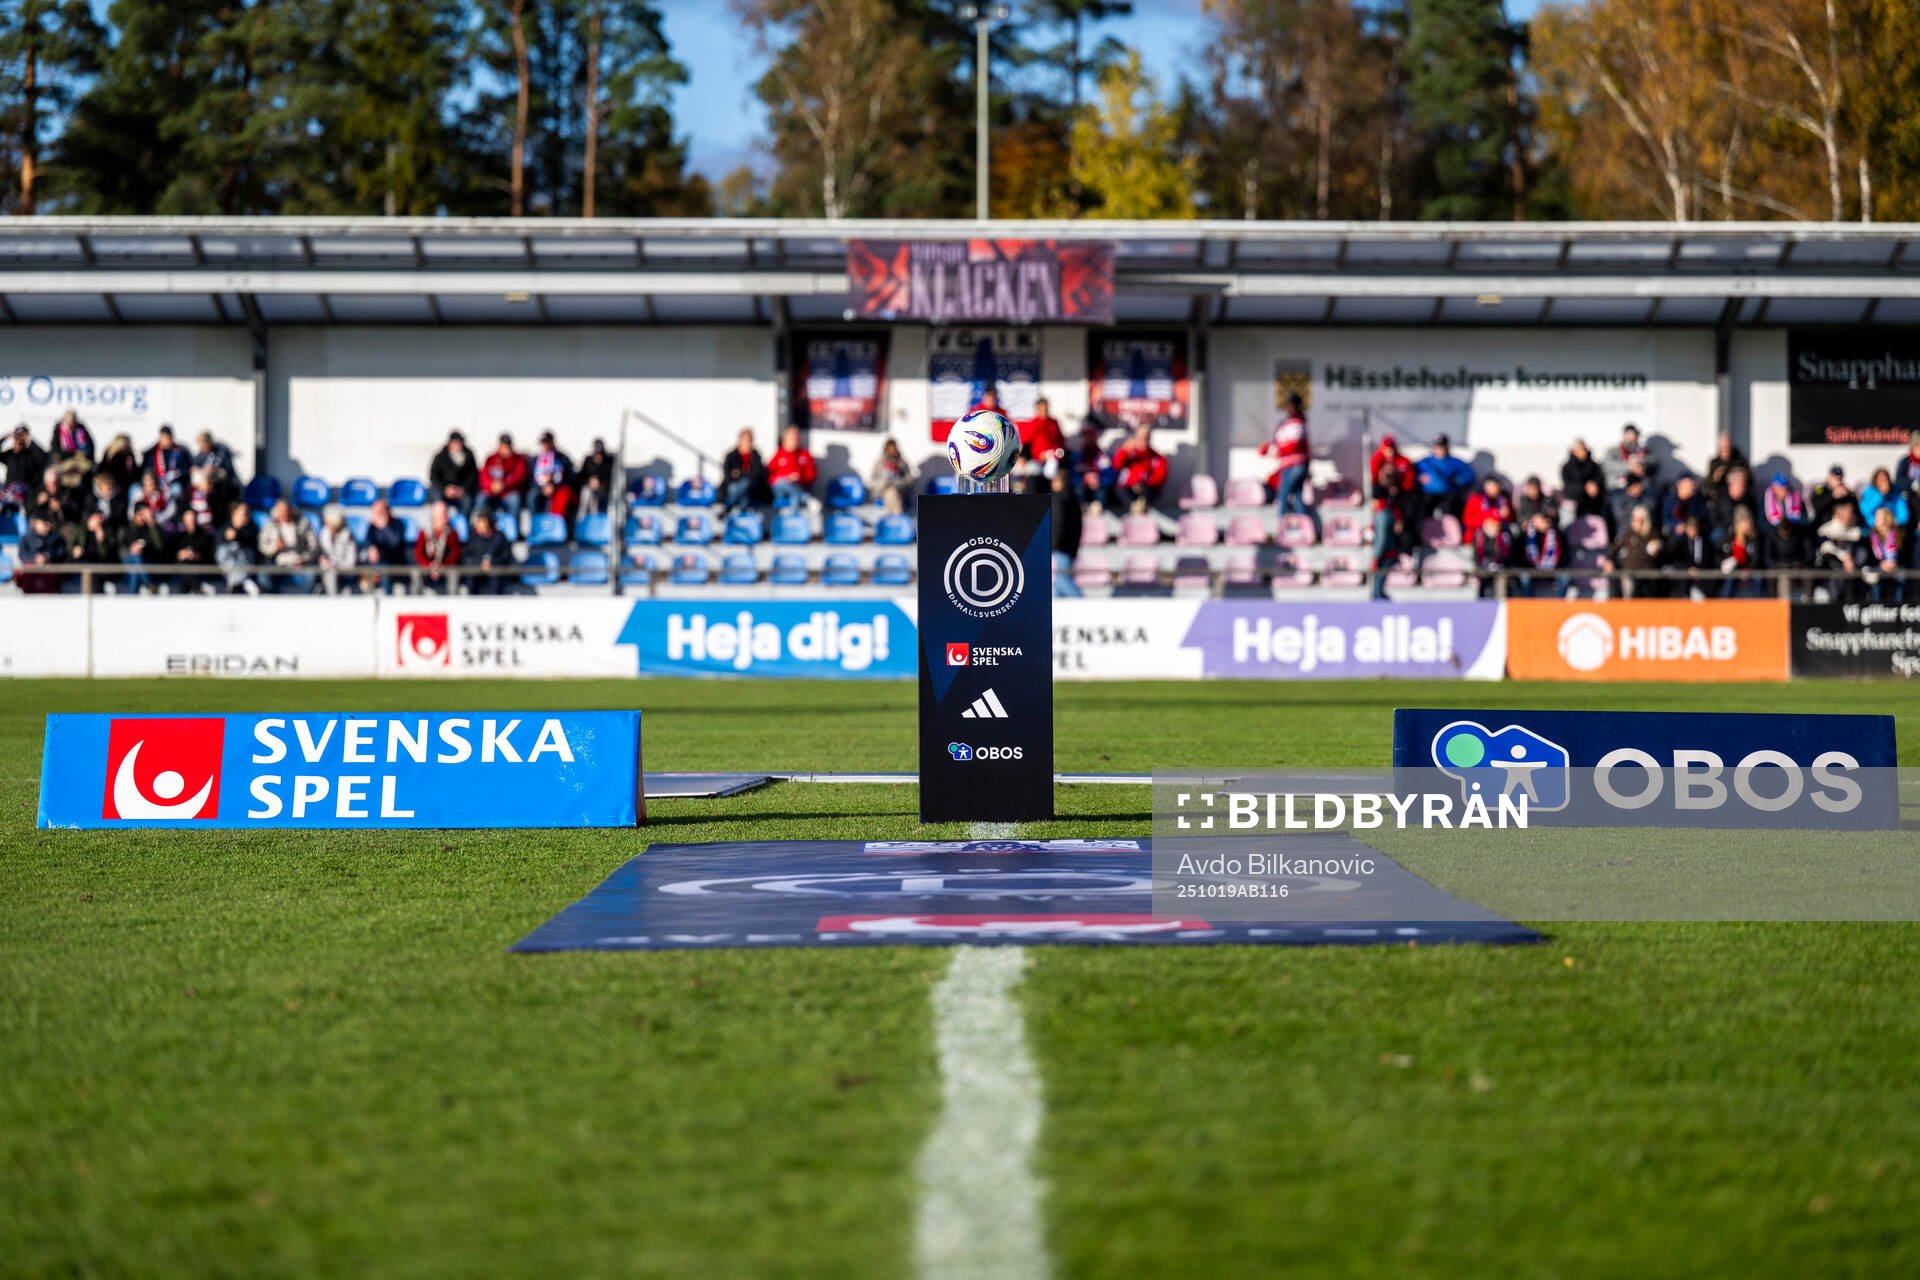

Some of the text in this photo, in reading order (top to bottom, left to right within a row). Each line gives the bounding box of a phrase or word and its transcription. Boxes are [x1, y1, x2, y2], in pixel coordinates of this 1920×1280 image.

[1324, 364, 1647, 389] Hässleholms kommun
[1798, 350, 1920, 390] Snappha
[27, 374, 148, 413] Omsorg
[969, 536, 1000, 547] OBOS
[948, 593, 1021, 618] DAMALLSVENSKAN
[461, 621, 585, 643] SVENSKA
[667, 610, 889, 671] Heja dig!
[1053, 625, 1149, 645] ENSKA
[1232, 613, 1454, 673] Heja alla!
[1619, 626, 1738, 660] HIBAB
[1806, 627, 1920, 656] Snapphaneb
[461, 647, 522, 668] SPEL
[972, 646, 1023, 656] SVENSKA
[972, 657, 999, 666] SPEL
[1053, 650, 1088, 670] EL
[166, 653, 300, 675] ERIDAN
[251, 717, 575, 764] SVENSKA
[976, 746, 1023, 760] OBOS
[1593, 747, 1864, 812] OBOS
[247, 774, 416, 818] SPEL
